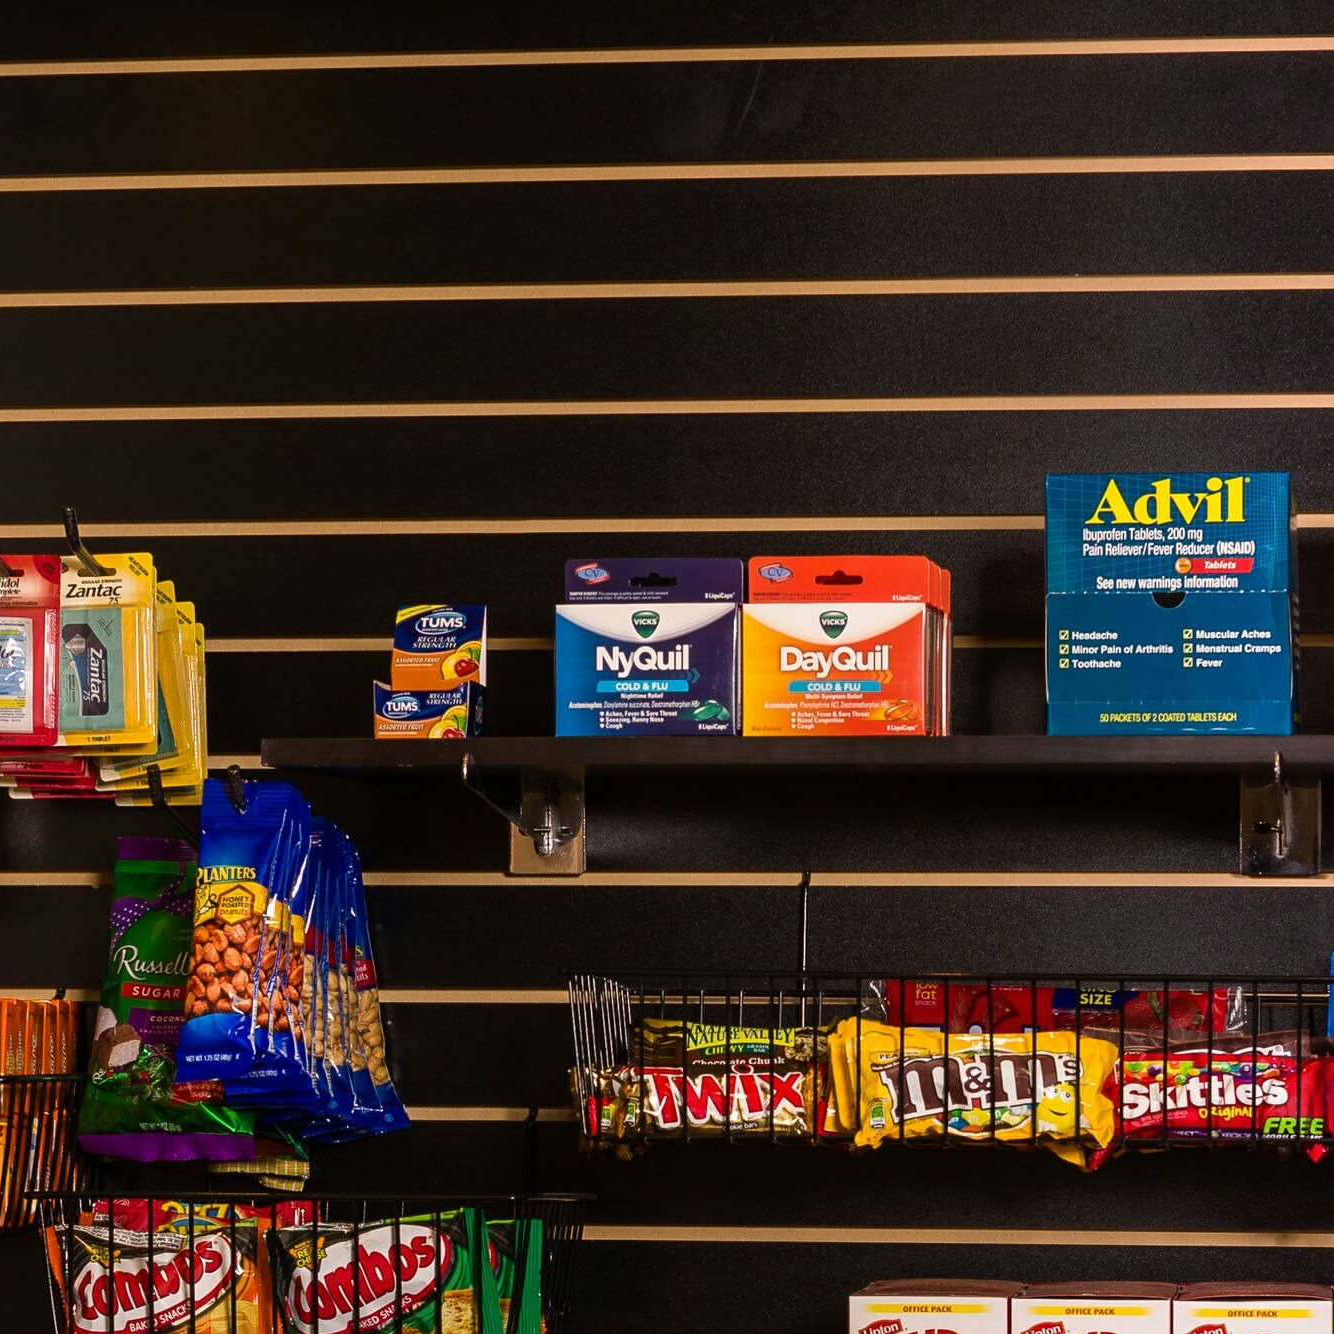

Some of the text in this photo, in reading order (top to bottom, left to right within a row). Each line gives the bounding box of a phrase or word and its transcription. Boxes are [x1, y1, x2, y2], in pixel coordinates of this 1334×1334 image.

[1085, 476, 1246, 525] Advil
[1083, 528, 1203, 541] Ibuprofen Tablets, 200 mg
[1083, 544, 1103, 556] Pain
[1176, 543, 1214, 555] Reducer
[1216, 541, 1255, 555] (NSAID)
[1204, 561, 1236, 569] Tablets
[1096, 577, 1238, 590] See new warnings information
[66, 584, 122, 598] Zantac
[420, 617, 463, 628] TUMS
[1072, 631, 1118, 639] Headache
[1196, 630, 1271, 639] Muscular Aches
[1101, 645, 1122, 653] Pain
[1124, 645, 1134, 653] of
[1136, 645, 1173, 653] Arthritis
[1196, 644, 1281, 654] Menstrual Cramps
[596, 644, 689, 678] NyQuil
[780, 645, 888, 678] DayQuil
[1072, 660, 1121, 668] Toothache
[1196, 659, 1222, 667] Fever
[90, 648, 102, 703] Zantac
[807, 683, 861, 691] COLD & FLU
[386, 702, 418, 711] TUMS
[197, 868, 256, 882] PLANTERS
[132, 986, 180, 998] SUGAR
[1080, 994, 1112, 1005] SIZE
[1123, 1075, 1288, 1119] Skittles
[1264, 1118, 1323, 1134] FREE
